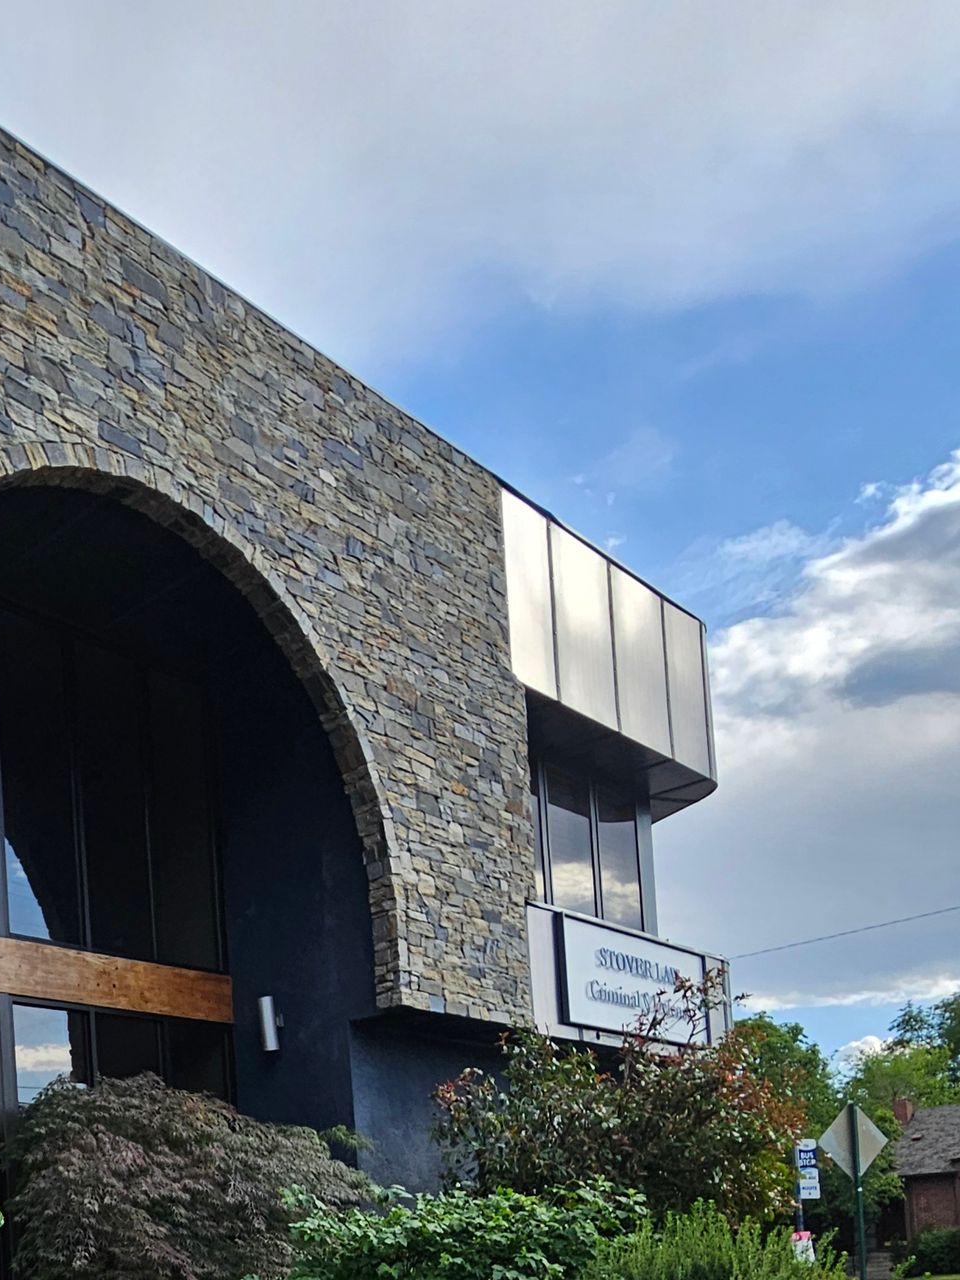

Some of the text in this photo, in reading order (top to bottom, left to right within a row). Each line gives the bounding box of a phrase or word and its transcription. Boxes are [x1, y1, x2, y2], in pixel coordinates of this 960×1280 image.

[598, 947, 653, 980] STOVER
[589, 980, 641, 1008] Criminal
[799, 1158, 816, 1166] STOP
